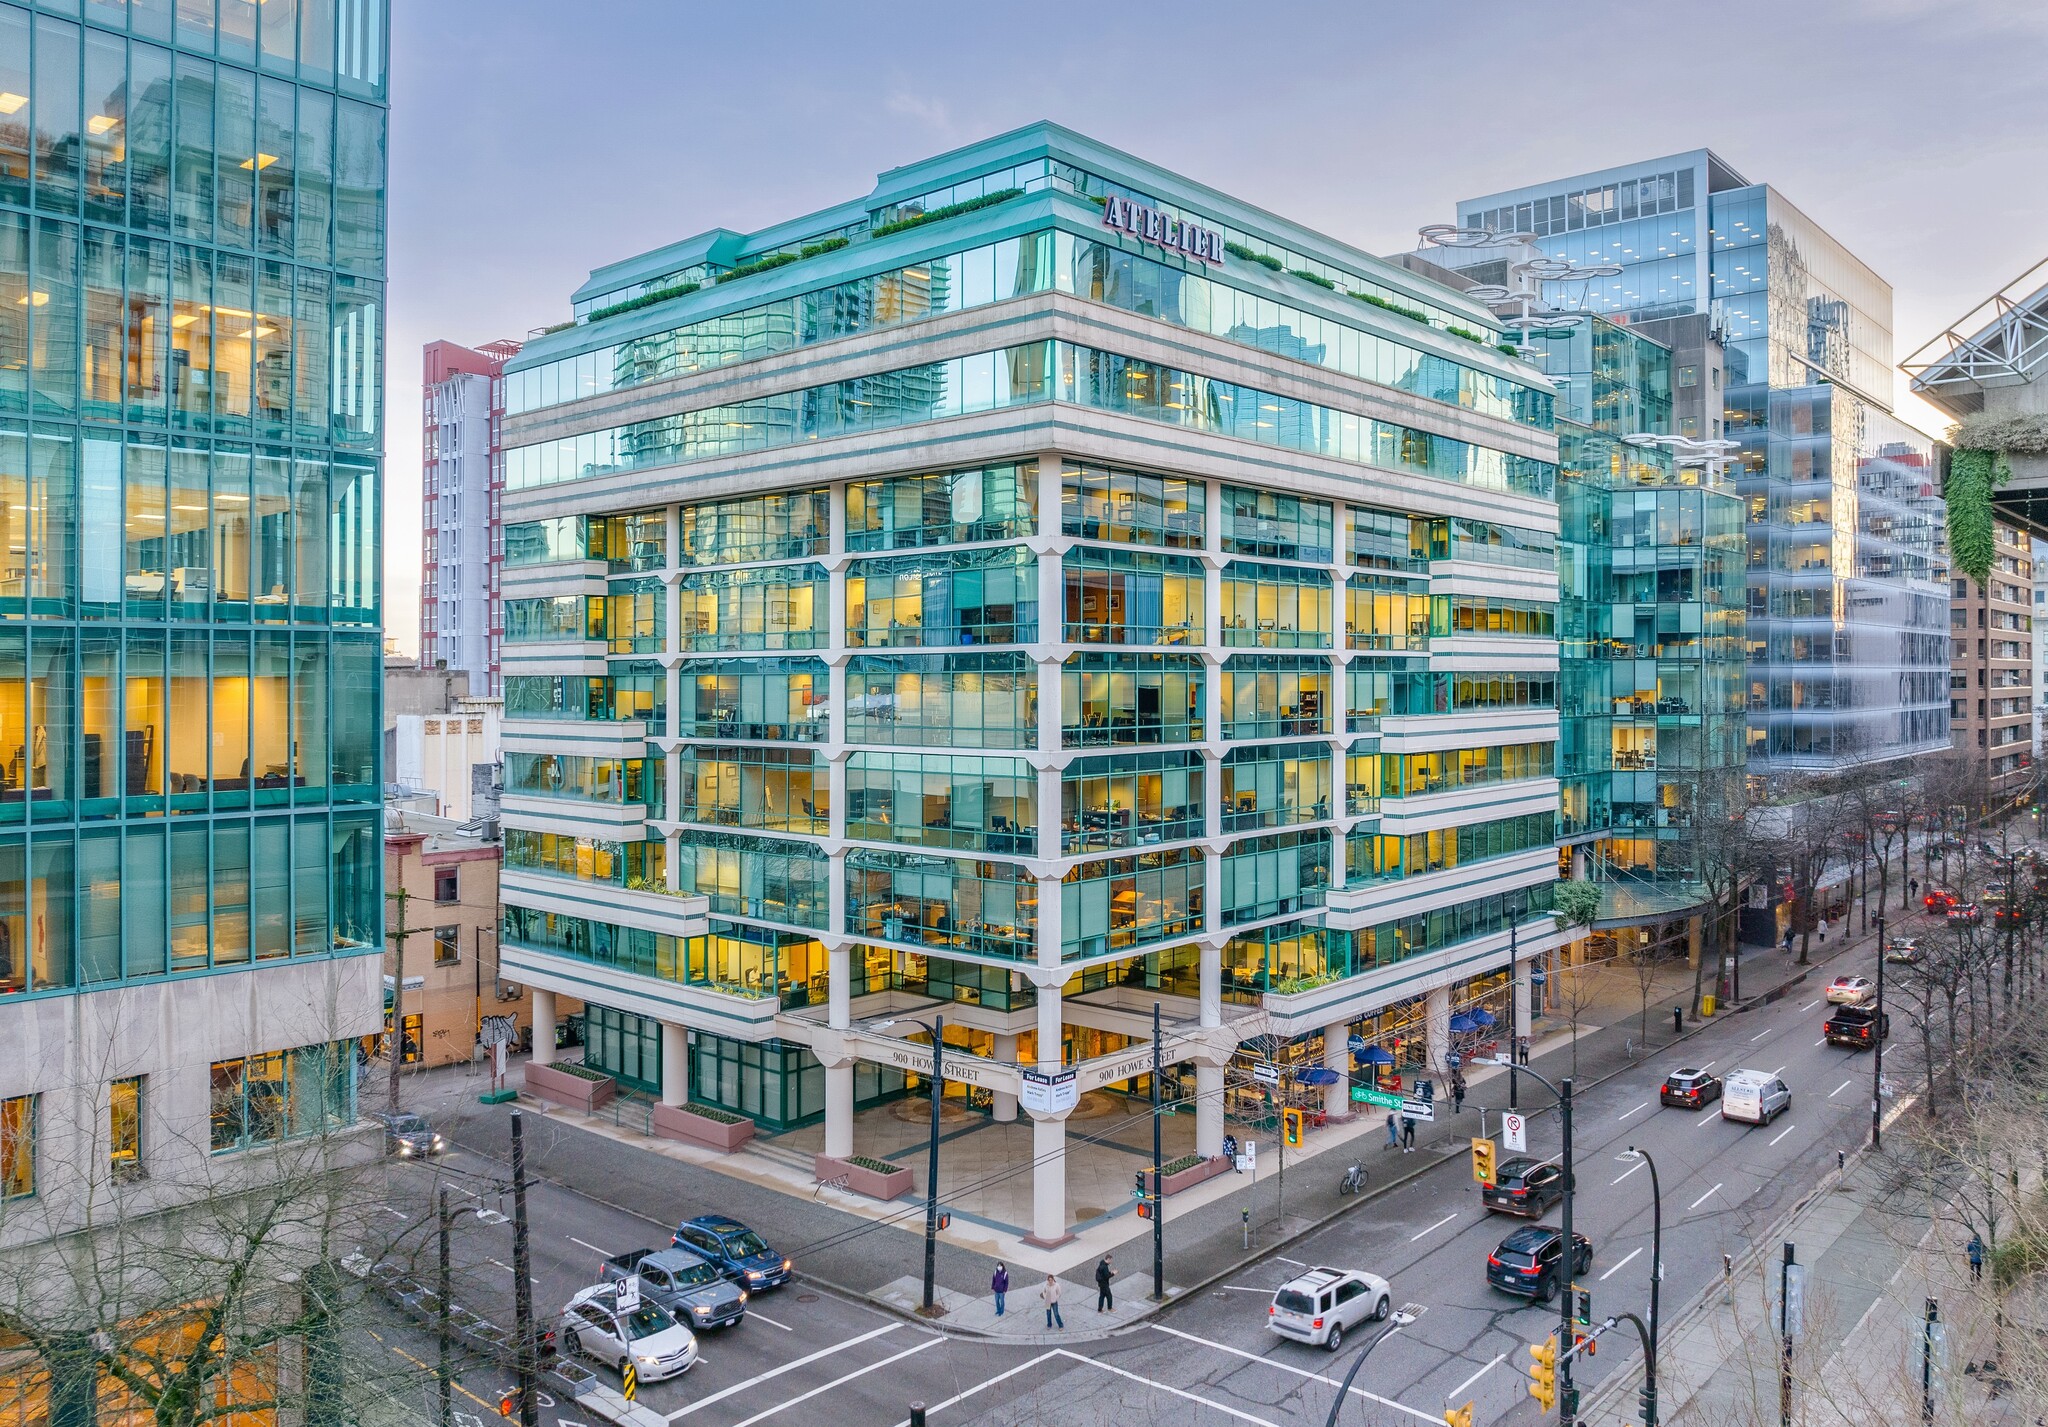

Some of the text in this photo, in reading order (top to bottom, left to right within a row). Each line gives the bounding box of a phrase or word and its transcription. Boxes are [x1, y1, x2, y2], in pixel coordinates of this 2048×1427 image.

[1104, 195, 1225, 265] ATELIER
[893, 1051, 979, 1081] 900 HOW STREET
[1099, 1049, 1176, 1082] 900 HOWE SEET
[1026, 1073, 1048, 1084] For Lease
[1055, 1073, 1075, 1084] For Lease
[1368, 1093, 1402, 1108] Smithe St
